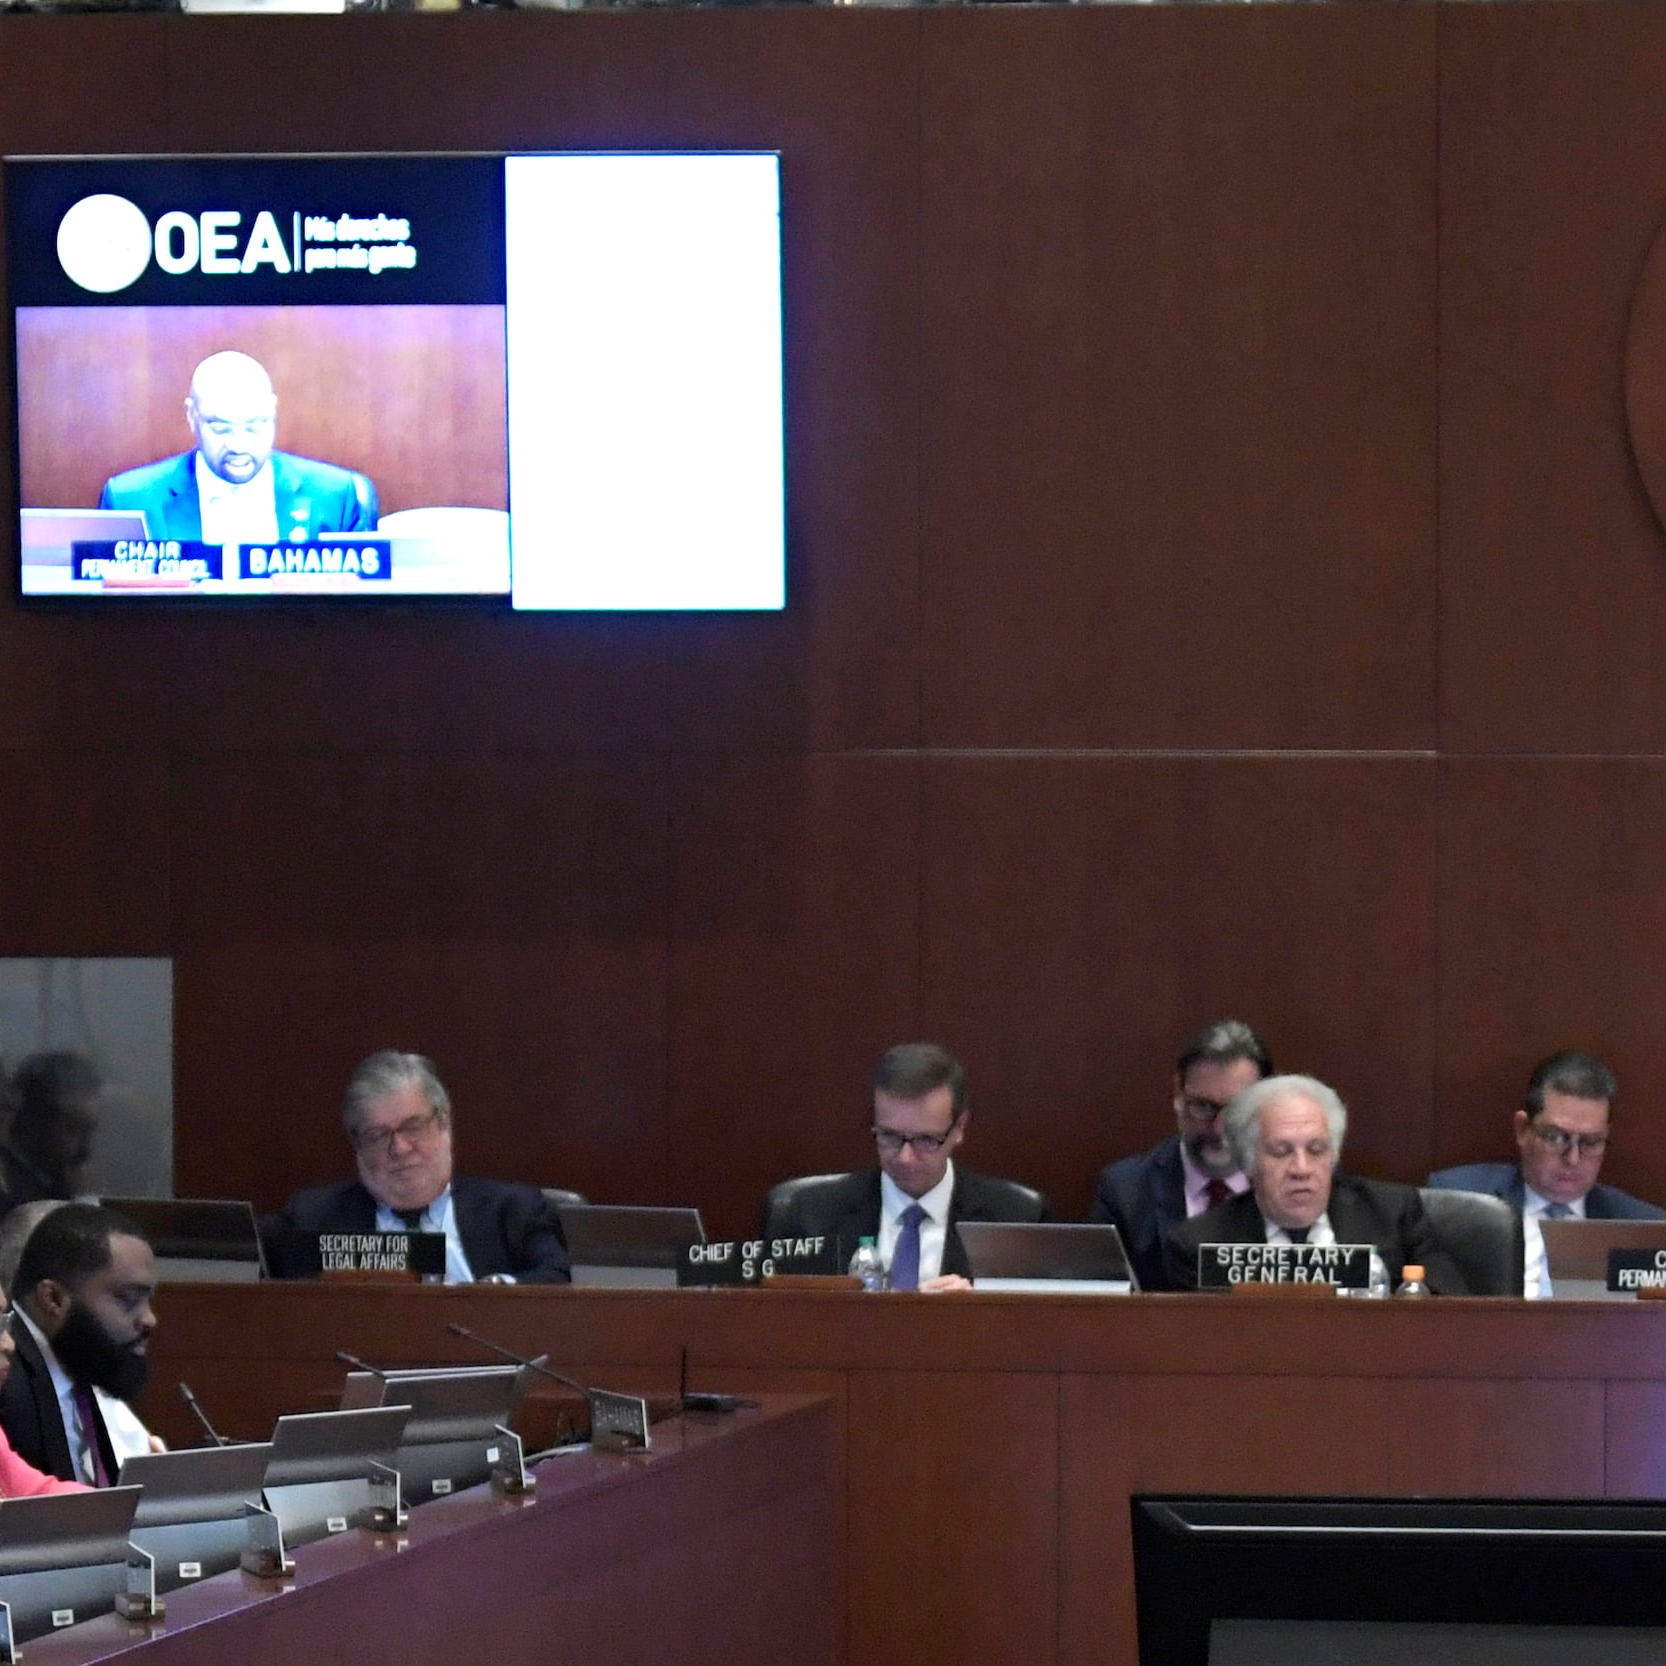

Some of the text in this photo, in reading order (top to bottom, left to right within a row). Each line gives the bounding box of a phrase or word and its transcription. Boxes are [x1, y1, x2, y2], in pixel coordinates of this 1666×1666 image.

[155, 211, 292, 274] OEA
[114, 541, 181, 559] CHAIR
[249, 548, 380, 574] BAHAMAS
[319, 1235, 408, 1252] SECRETARY FOR
[688, 1236, 825, 1263] CHIEF OF STAFF
[322, 1252, 406, 1270] LEGAL AFFAIRS
[1217, 1247, 1354, 1265] SECRETARY
[1227, 1266, 1342, 1285] GENERAL
